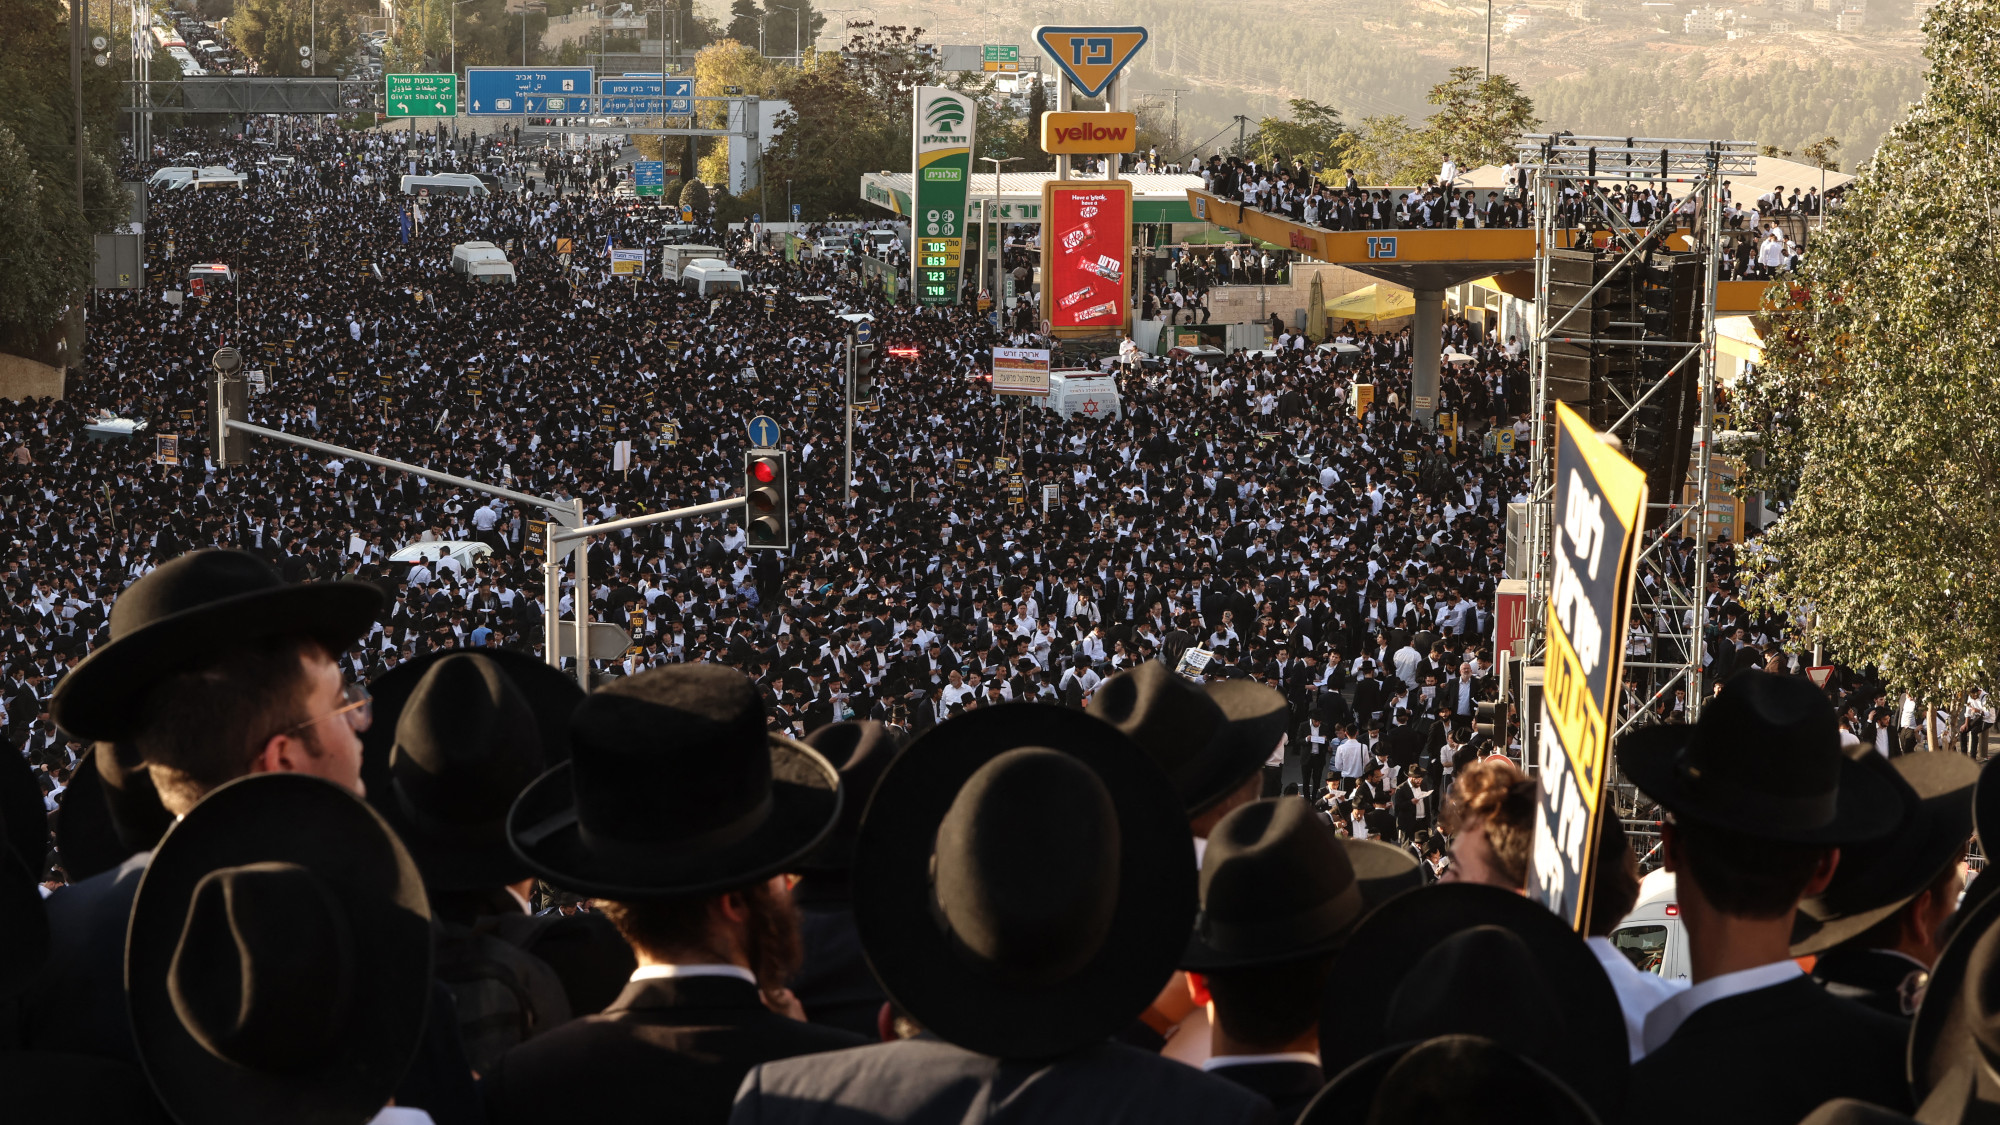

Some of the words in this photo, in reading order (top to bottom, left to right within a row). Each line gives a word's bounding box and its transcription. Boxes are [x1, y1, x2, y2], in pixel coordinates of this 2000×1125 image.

[1070, 38, 1113, 65] פז
[392, 76, 411, 84] שאול
[923, 134, 948, 144] אלון
[1055, 122, 1128, 144] yellow
[928, 170, 958, 178] אלונית
[928, 242, 946, 252] 7.05
[1367, 237, 1397, 258] פז
[927, 256, 946, 266] 8.69
[1098, 254, 1120, 272] חדש
[926, 272, 944, 281] 7.23
[1565, 468, 1605, 581] לעם
[1552, 524, 1602, 675] ישראל
[1558, 770, 1586, 874] אין
